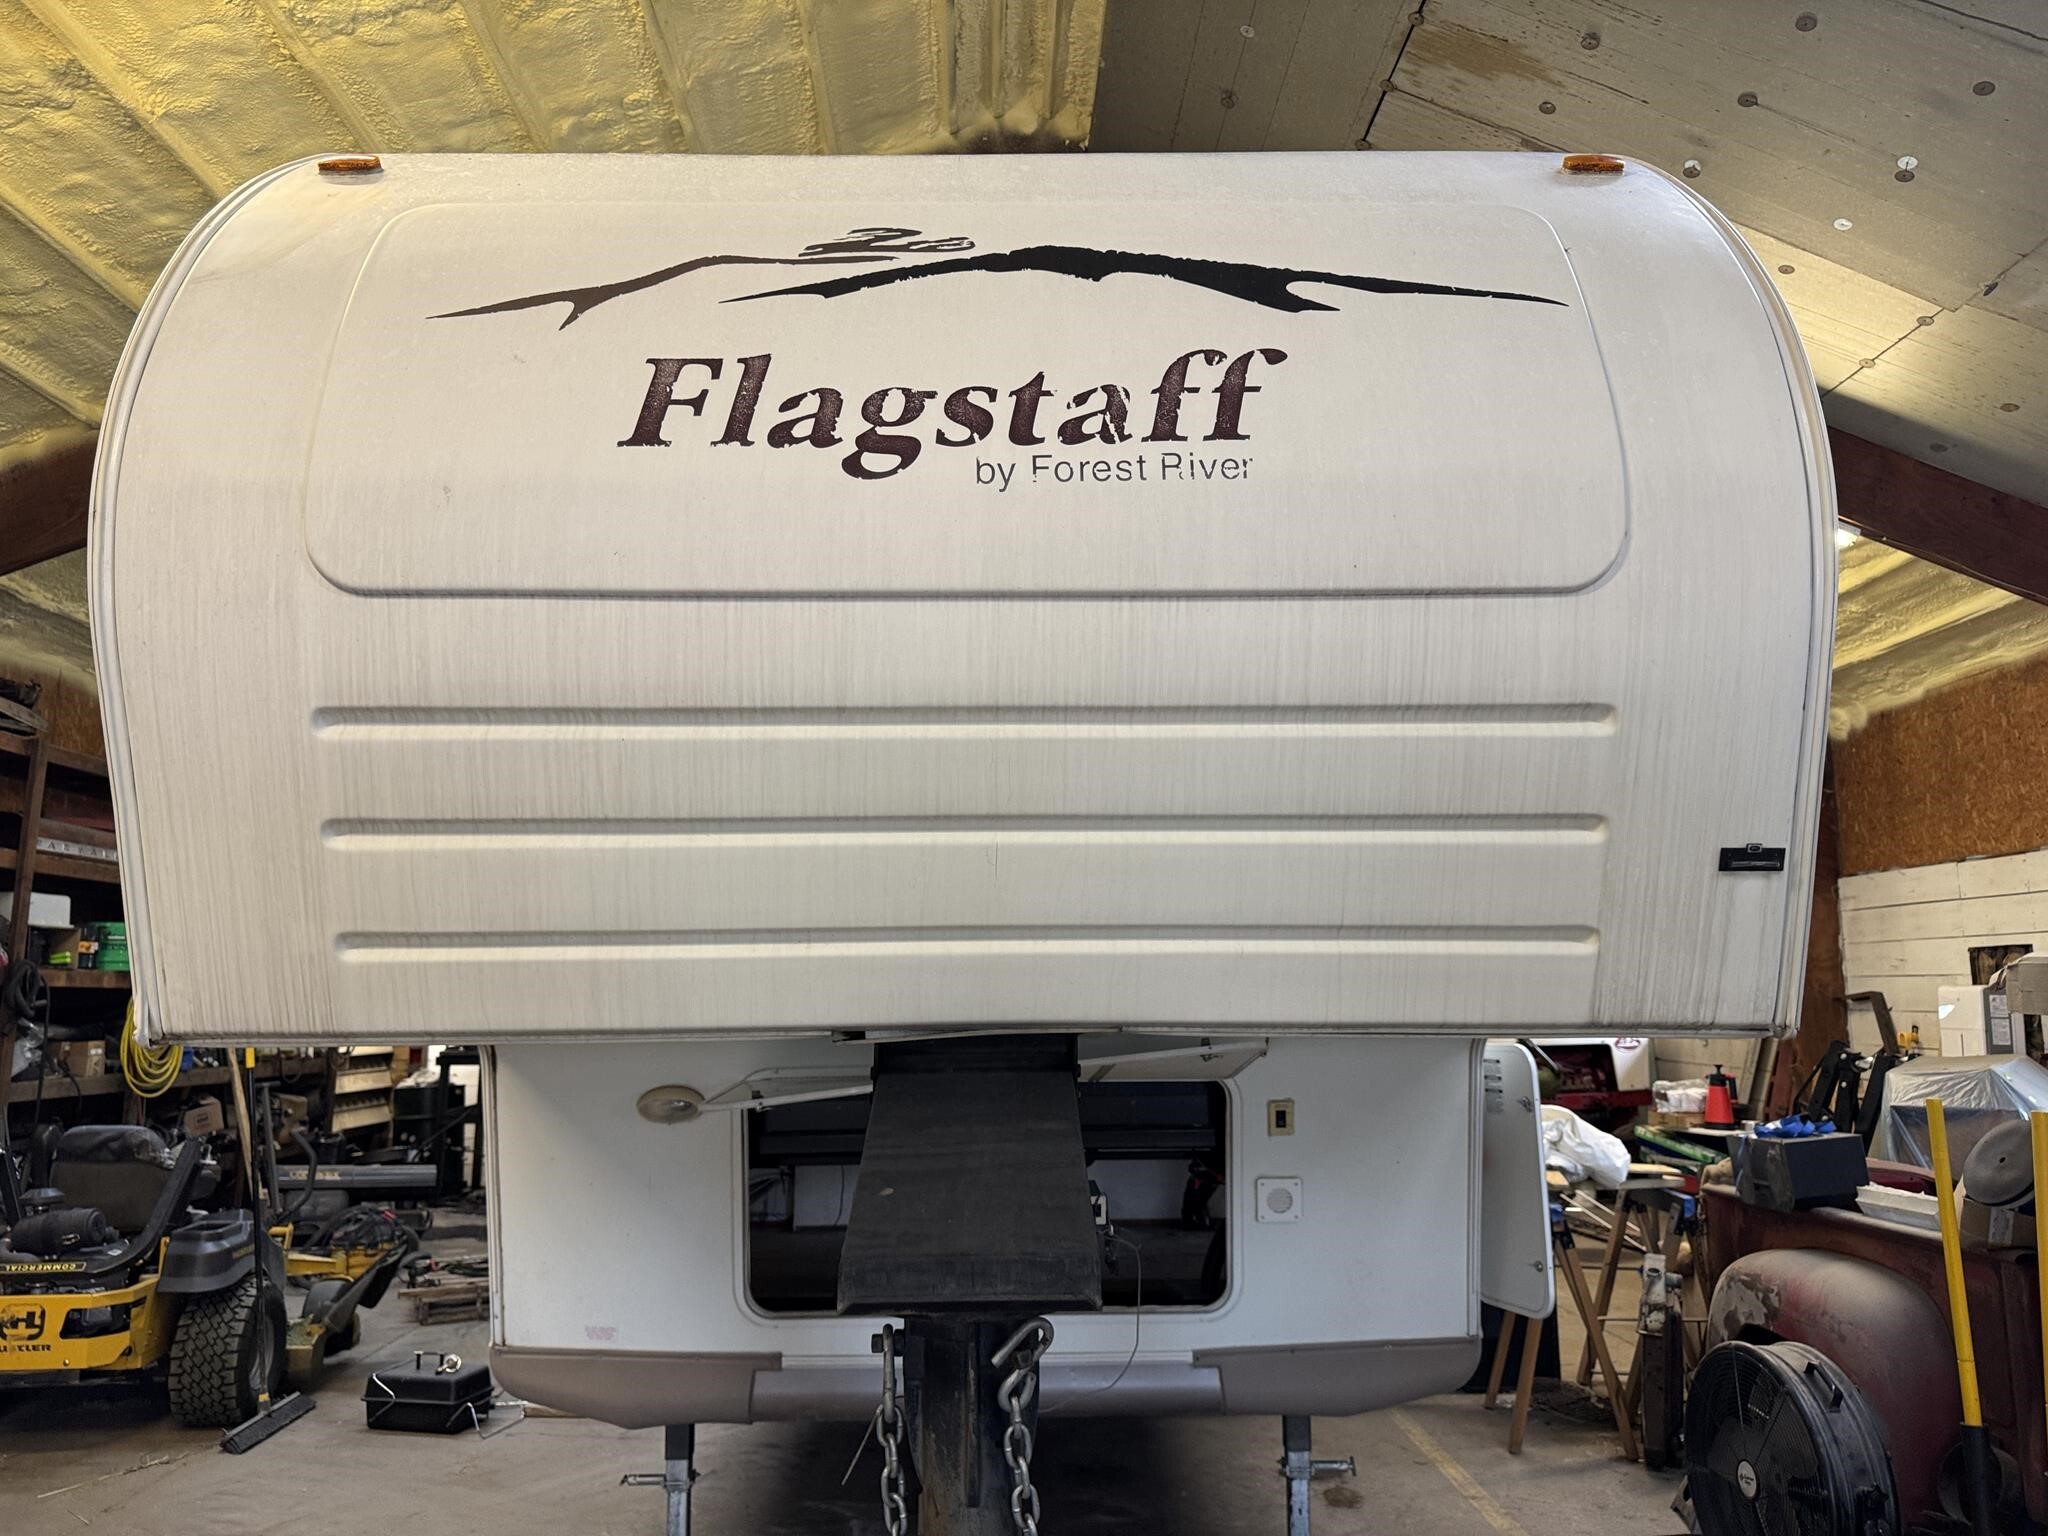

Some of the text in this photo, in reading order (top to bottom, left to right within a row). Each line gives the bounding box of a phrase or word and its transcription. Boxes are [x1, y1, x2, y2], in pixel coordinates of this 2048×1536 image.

[616, 348, 1288, 480] Flagstaff
[976, 452, 1253, 493] by Forest River
